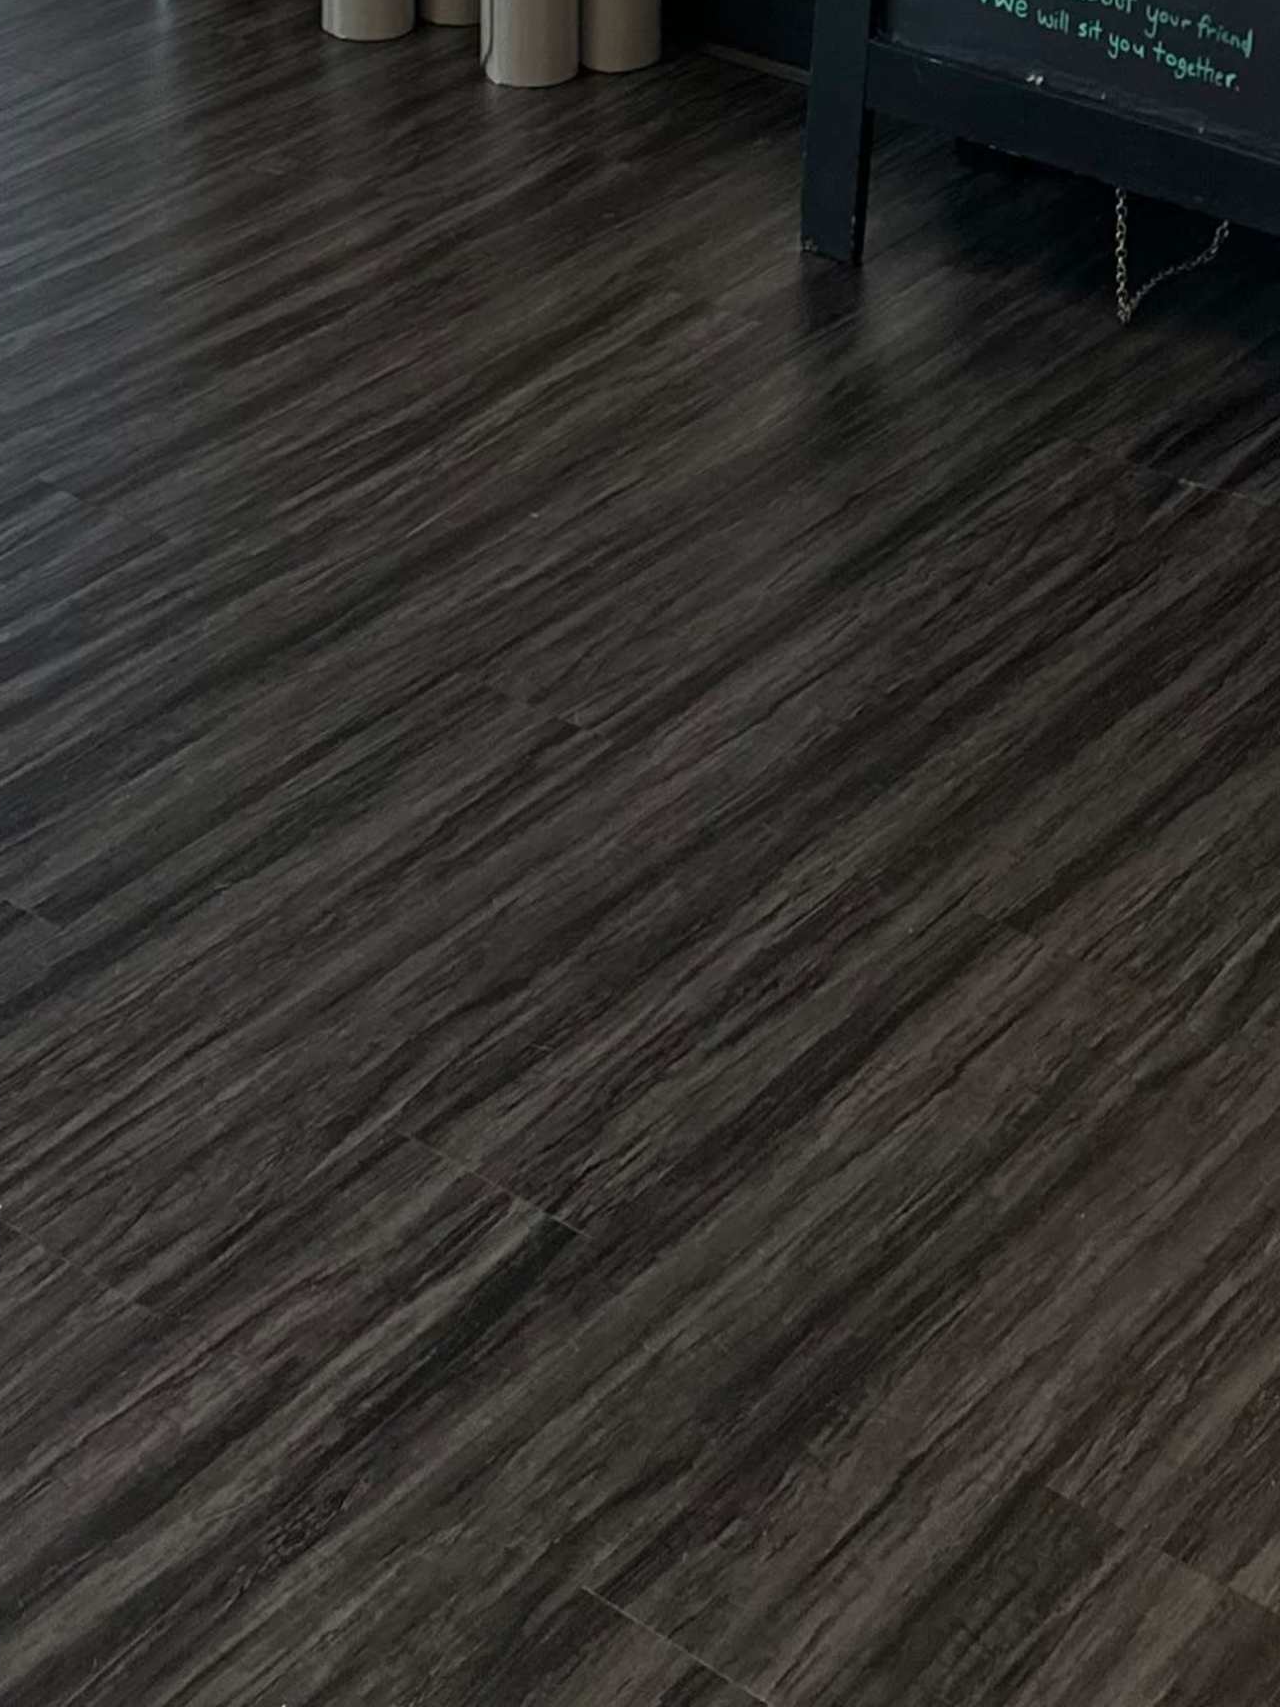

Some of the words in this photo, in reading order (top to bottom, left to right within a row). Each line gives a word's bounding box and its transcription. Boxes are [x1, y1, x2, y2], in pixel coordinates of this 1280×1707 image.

[1037, 8, 1069, 34] will
[1109, 35, 1145, 59] you
[1146, 4, 1192, 38] your
[1198, 16, 1253, 59] friend
